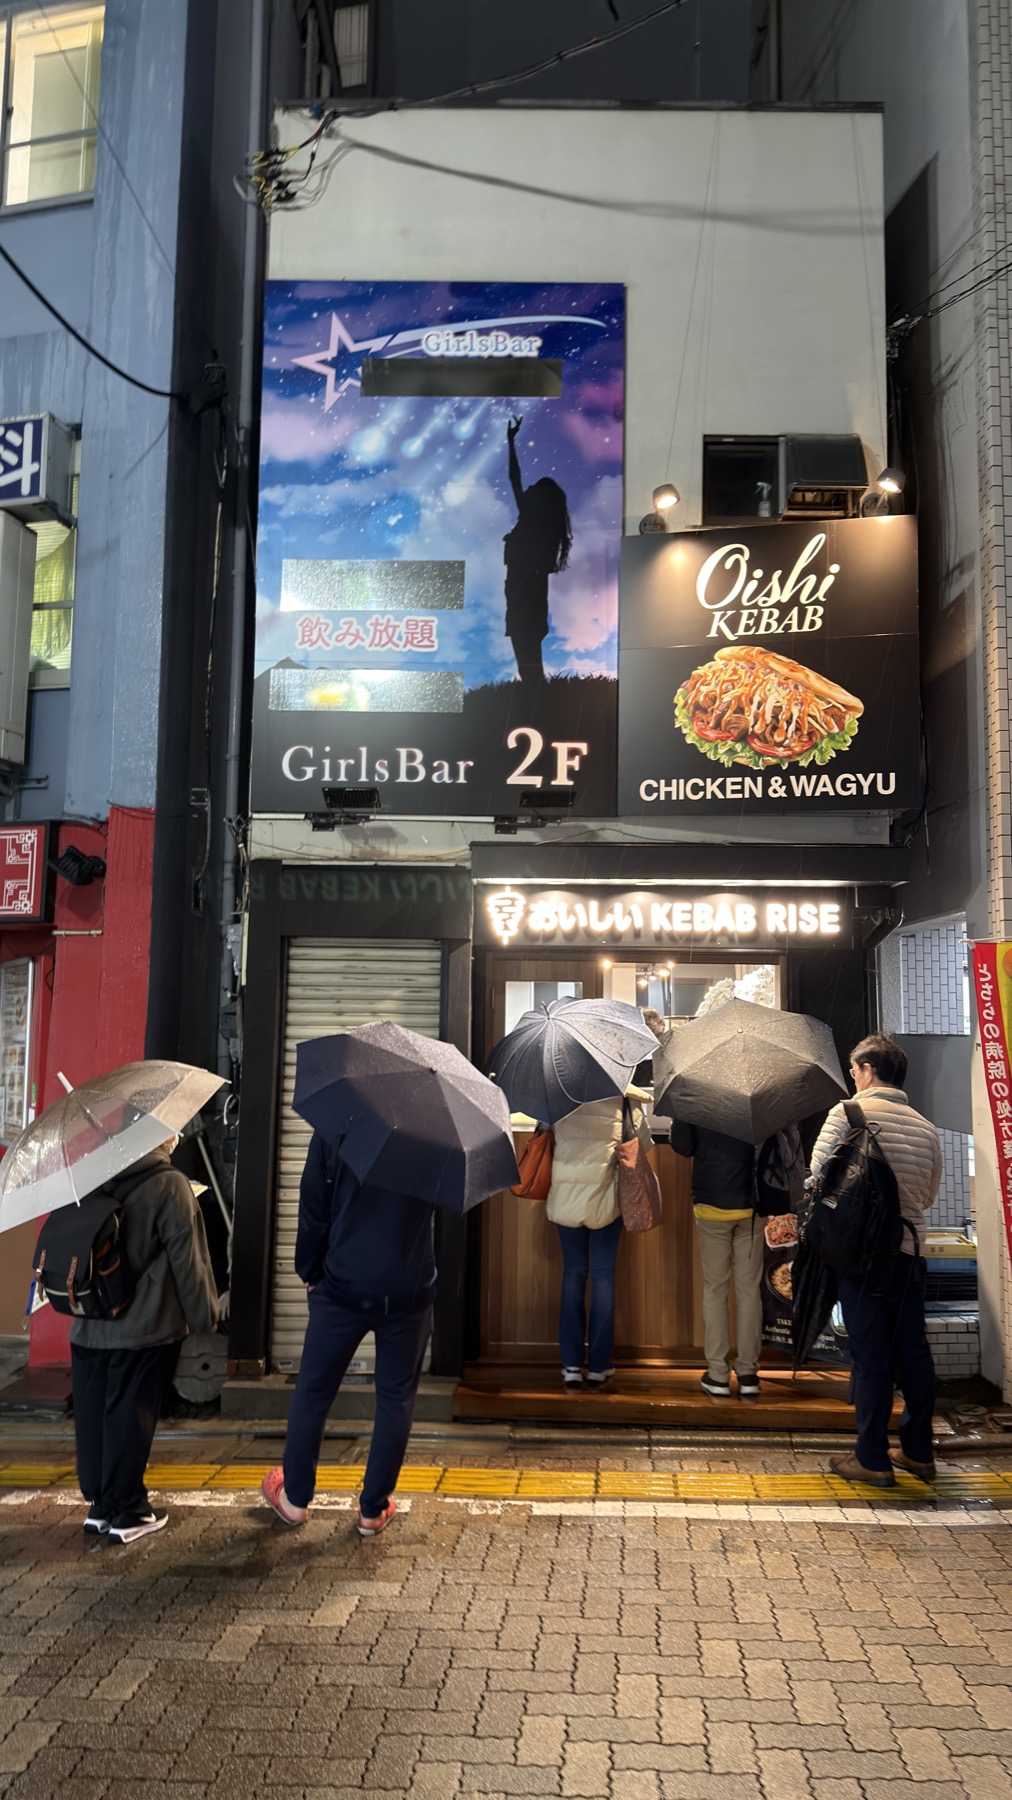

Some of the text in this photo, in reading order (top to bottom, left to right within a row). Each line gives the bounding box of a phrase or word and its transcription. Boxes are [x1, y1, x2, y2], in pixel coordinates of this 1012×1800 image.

[423, 331, 541, 355] GirlsBar
[696, 532, 841, 609] Oishi
[298, 616, 438, 651] 飲み放題
[706, 605, 824, 640] KEBAB
[281, 727, 588, 788] GirlsBar 2F
[639, 772, 897, 802] CHICKEN & WAGYU
[527, 899, 841, 933] おいしい KEBAB RISE
